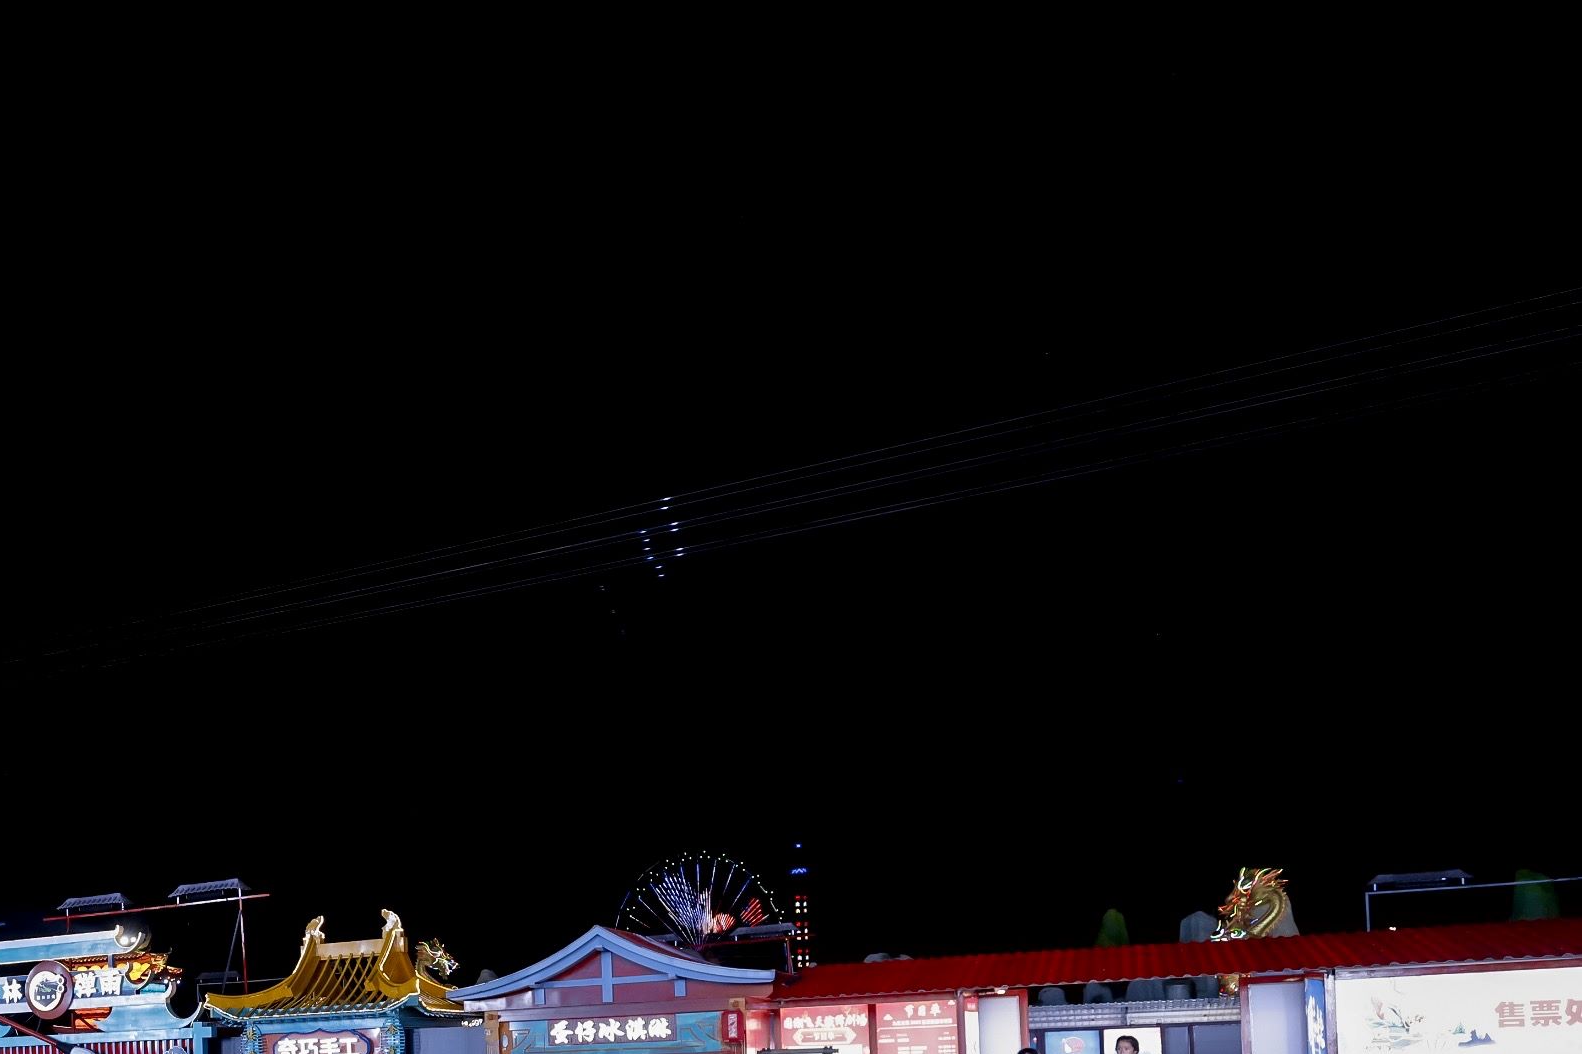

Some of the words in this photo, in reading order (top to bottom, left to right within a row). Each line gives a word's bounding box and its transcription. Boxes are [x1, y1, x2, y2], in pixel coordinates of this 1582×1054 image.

[904, 1002, 941, 1018] 节目单
[550, 1016, 672, 1044] 蛋仔冰淇淋
